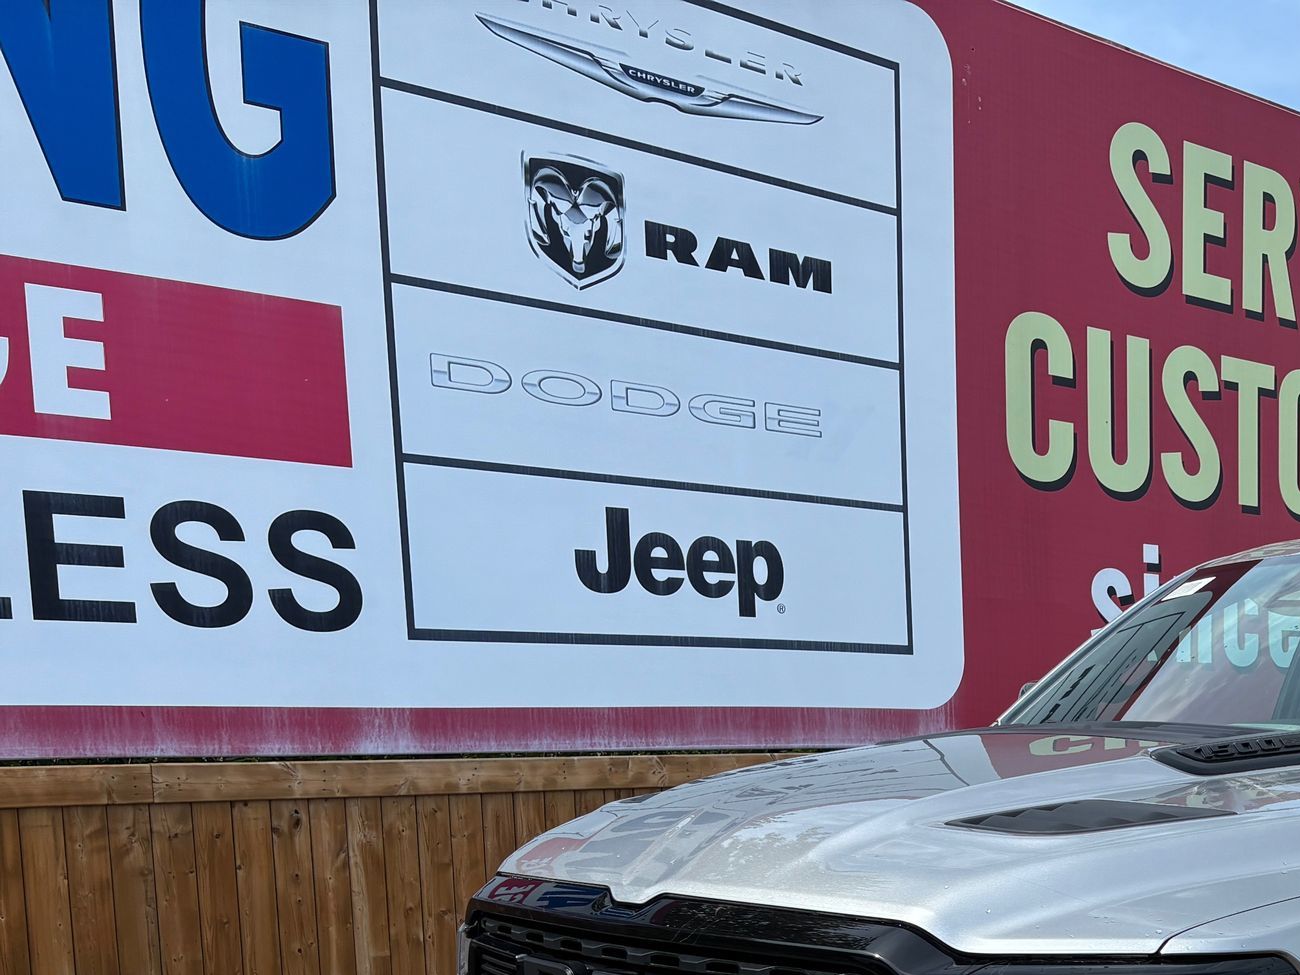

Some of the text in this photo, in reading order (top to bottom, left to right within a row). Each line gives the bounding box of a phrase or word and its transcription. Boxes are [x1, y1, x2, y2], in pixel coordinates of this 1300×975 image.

[520, 0, 804, 87] HRYSLER
[628, 67, 697, 95] CHRYSLER
[644, 219, 832, 294] RAM
[0, 282, 112, 422] E
[429, 353, 823, 438] DODGE
[0, 489, 364, 632] ESS
[574, 506, 785, 617] Jeep
[1194, 737, 1282, 760] 1500
